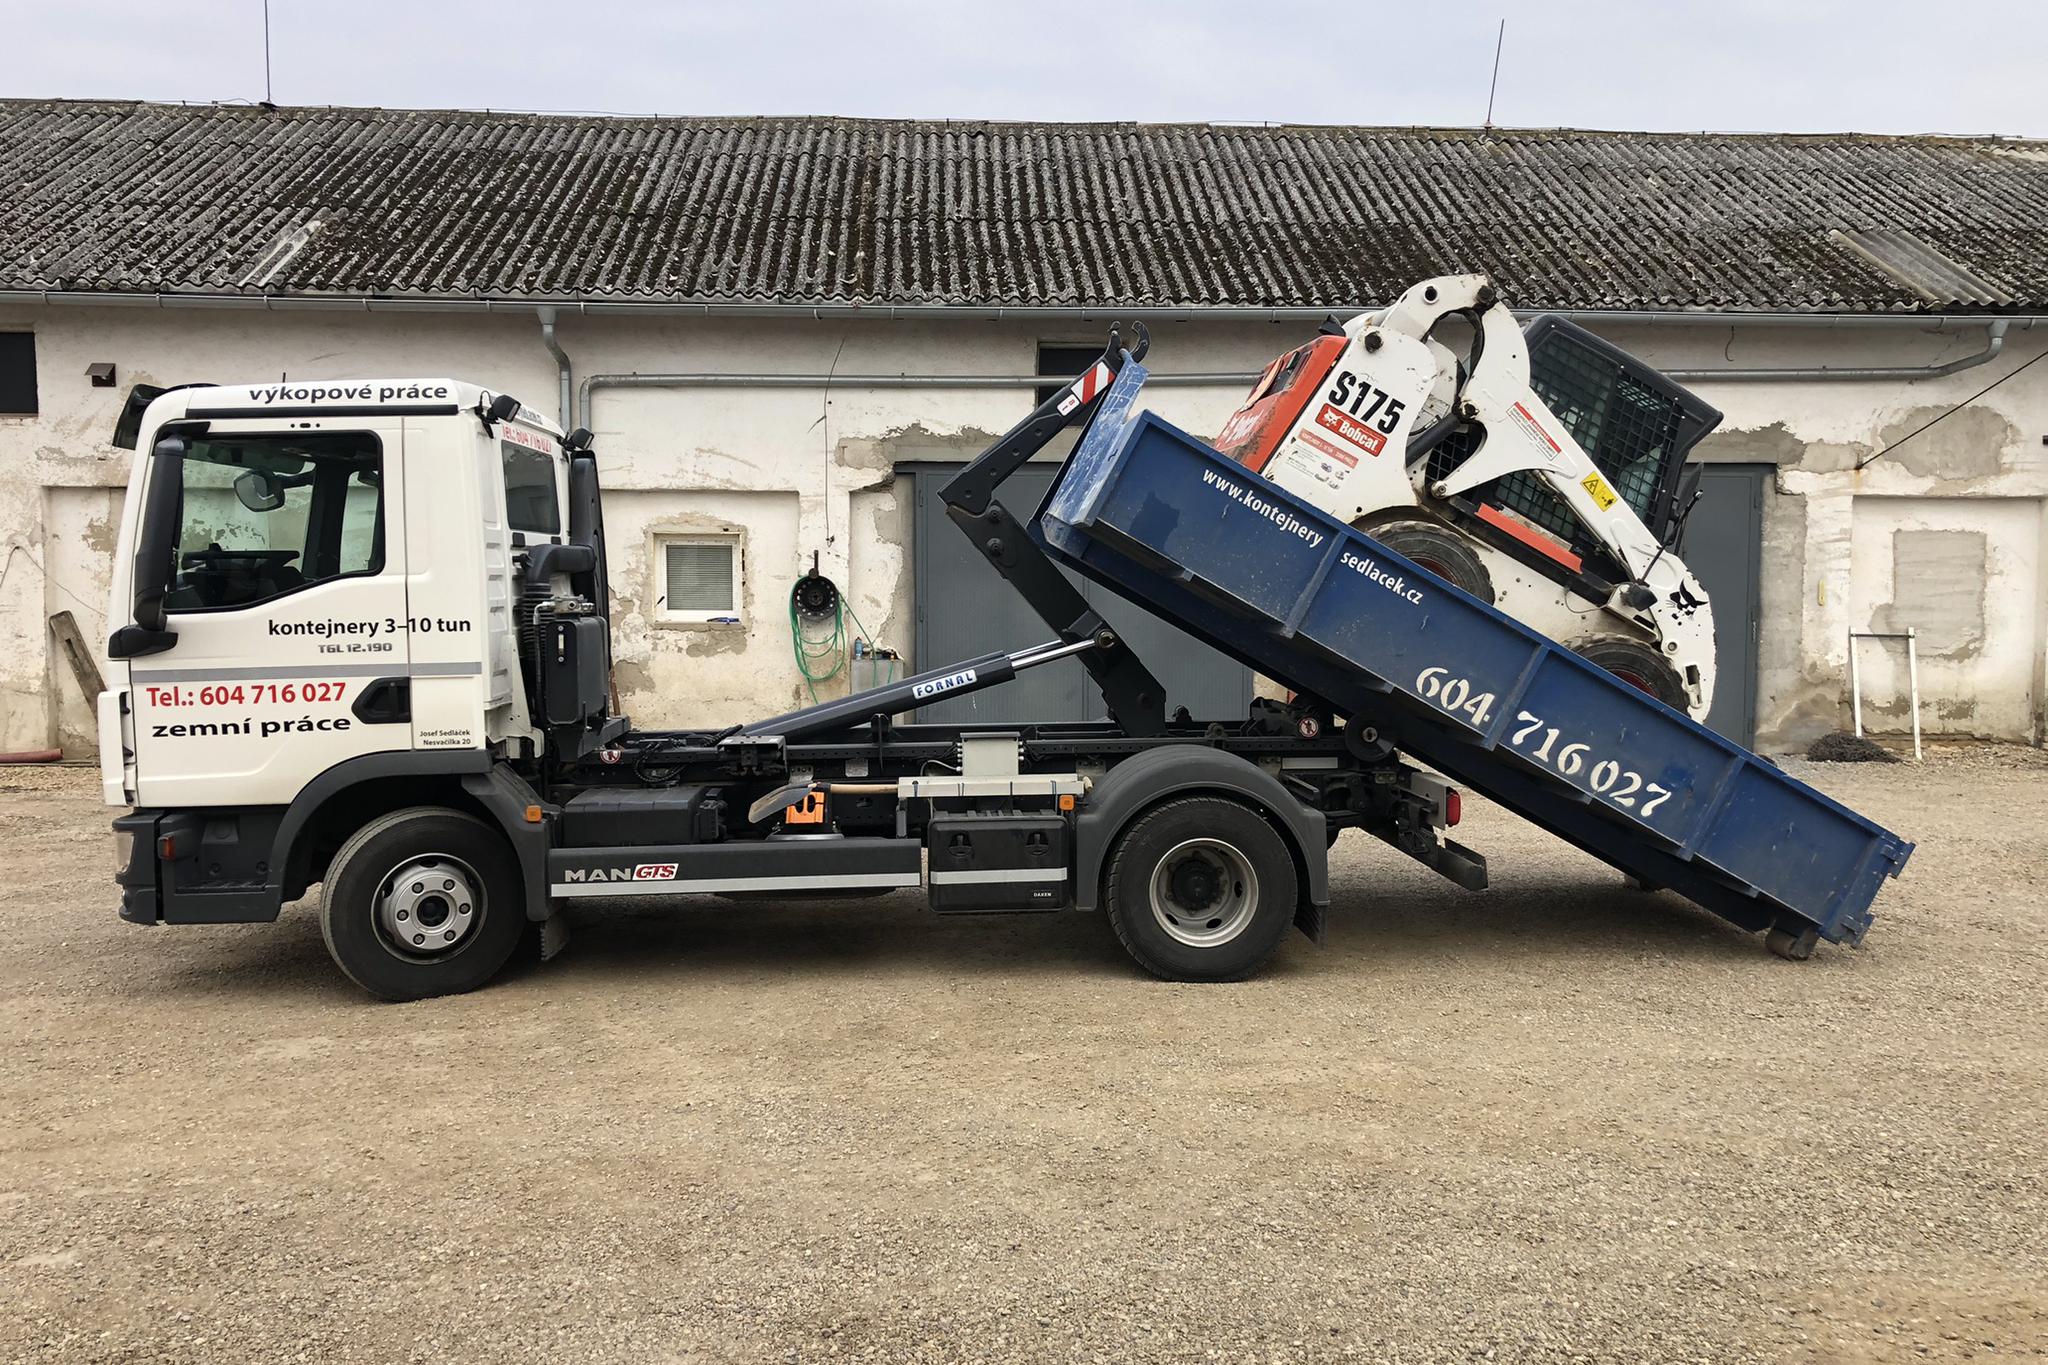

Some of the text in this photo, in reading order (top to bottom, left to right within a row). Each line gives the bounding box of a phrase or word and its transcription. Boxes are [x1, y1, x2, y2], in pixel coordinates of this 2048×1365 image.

[249, 384, 448, 405] výkopové práce
[1328, 371, 1406, 434] S175
[1338, 421, 1379, 452] Bobcat
[1203, 469, 1424, 605] www.kontejnery sedlacek.cz
[269, 619, 379, 638] kontejnery
[438, 618, 471, 632] tun
[318, 643, 392, 653] TGL 12.190
[146, 682, 346, 706] Tel.: 604 716 027
[917, 673, 973, 697] FORNAL
[152, 715, 351, 738] zemní práce
[1416, 667, 1672, 817] 604 716 027
[565, 868, 632, 882] MAN
